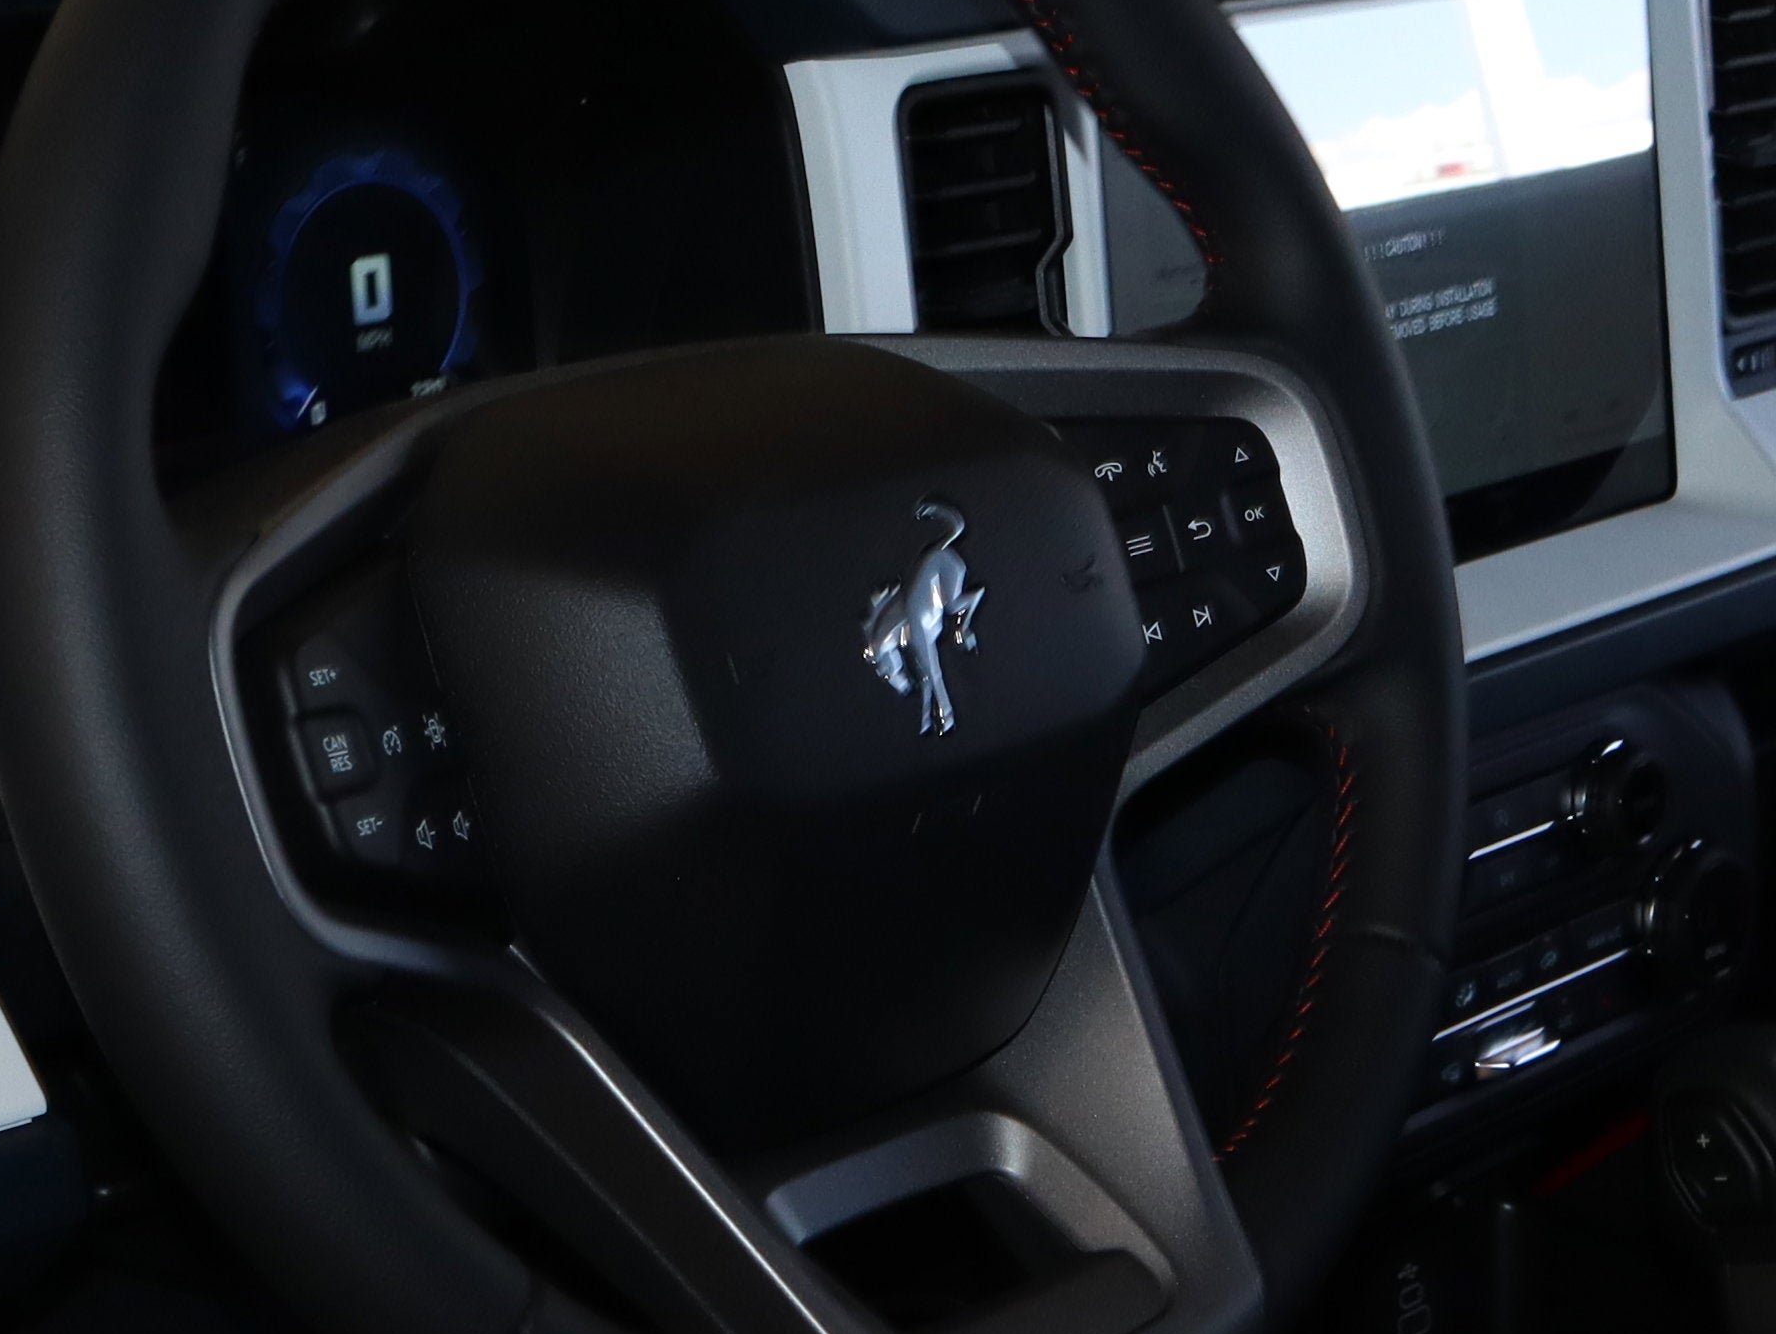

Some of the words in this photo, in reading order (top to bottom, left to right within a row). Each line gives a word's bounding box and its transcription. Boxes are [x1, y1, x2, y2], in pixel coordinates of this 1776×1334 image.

[350, 251, 394, 327] 0
[1434, 276, 1495, 308] INSTALLATION
[1428, 305, 1465, 332] BEFORE
[1243, 503, 1266, 524] OK
[308, 666, 339, 687] SET+
[322, 733, 348, 753] CAN
[329, 754, 354, 773] RES
[355, 815, 385, 837] SET-
